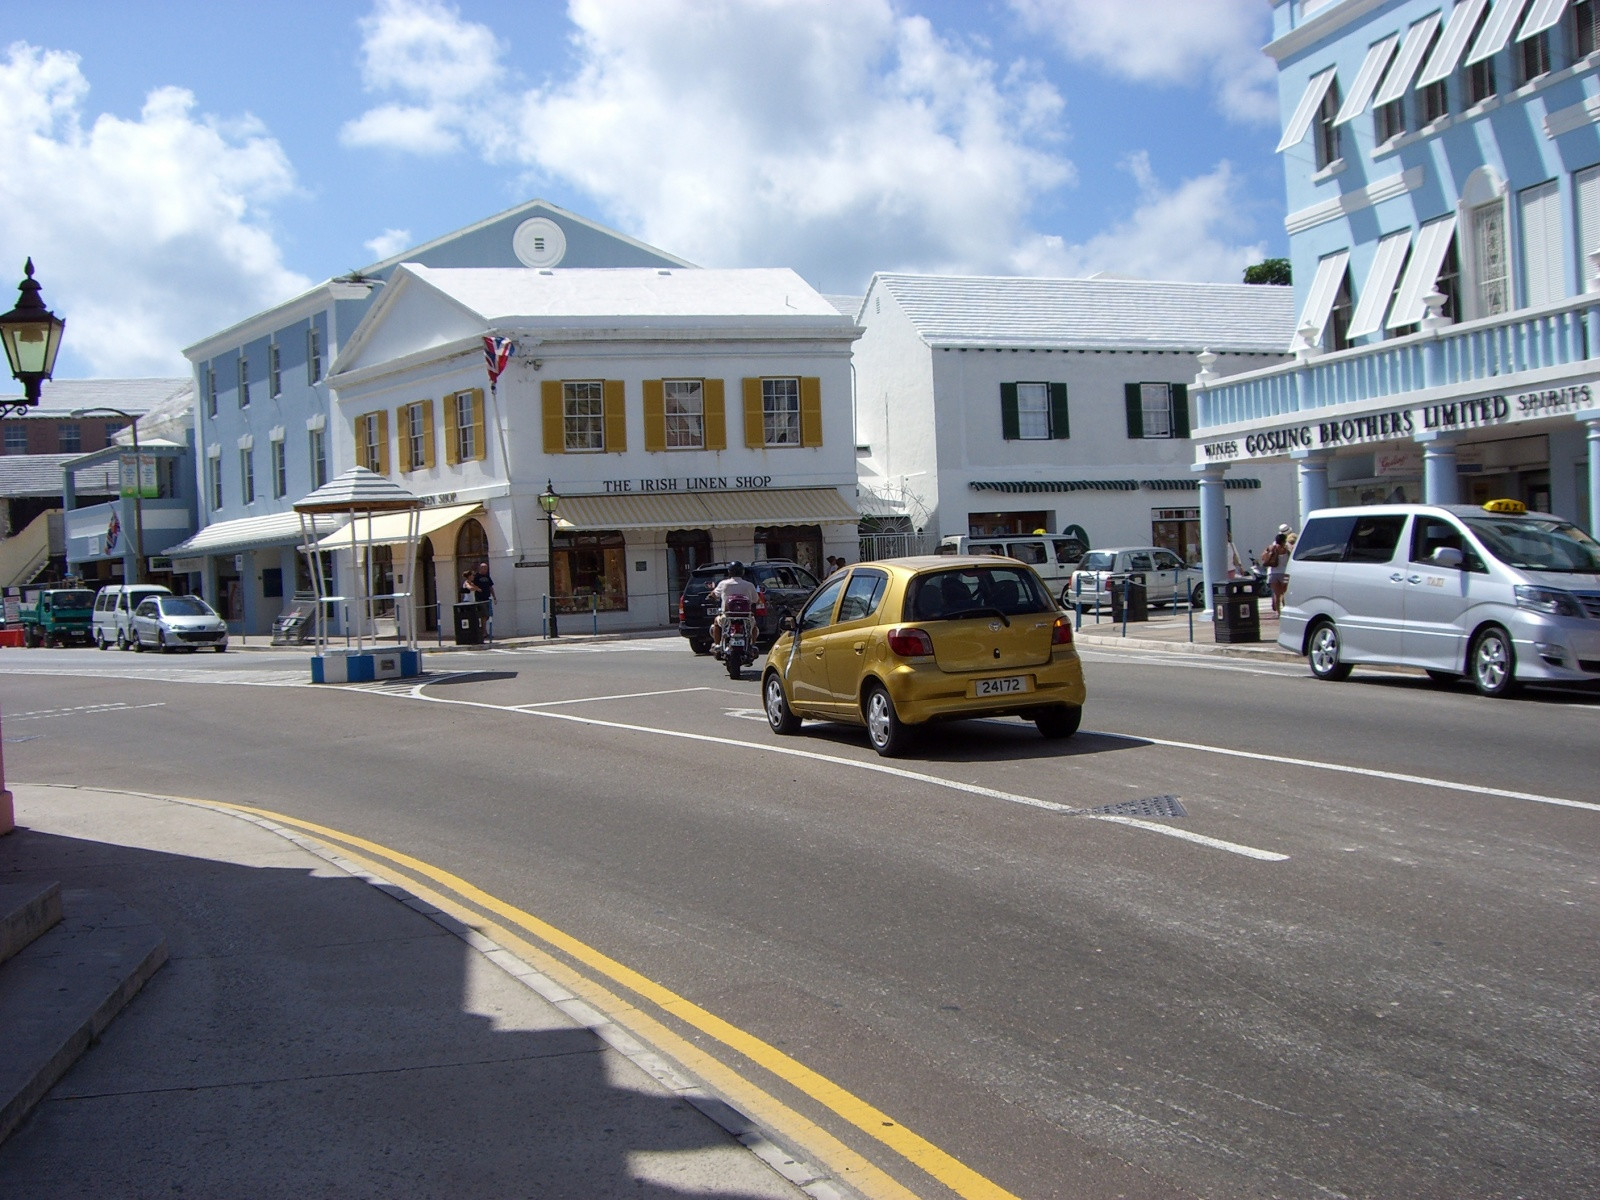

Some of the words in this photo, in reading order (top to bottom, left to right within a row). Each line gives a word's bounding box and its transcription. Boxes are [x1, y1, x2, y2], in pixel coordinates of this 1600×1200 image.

[1204, 441, 1237, 456] WINES
[1245, 426, 1311, 453] GOSLING
[1319, 410, 1414, 443] BROTHERS
[1423, 395, 1509, 428] LIMITED
[1517, 385, 1591, 411] SPIRITS
[603, 480, 632, 492] THE
[640, 479, 677, 491] IRISH
[686, 477, 728, 490] LINEN
[735, 476, 772, 488] SHOP
[438, 492, 457, 504] SHOP
[1496, 502, 1524, 511] TAXI
[982, 679, 1020, 693] 24172
